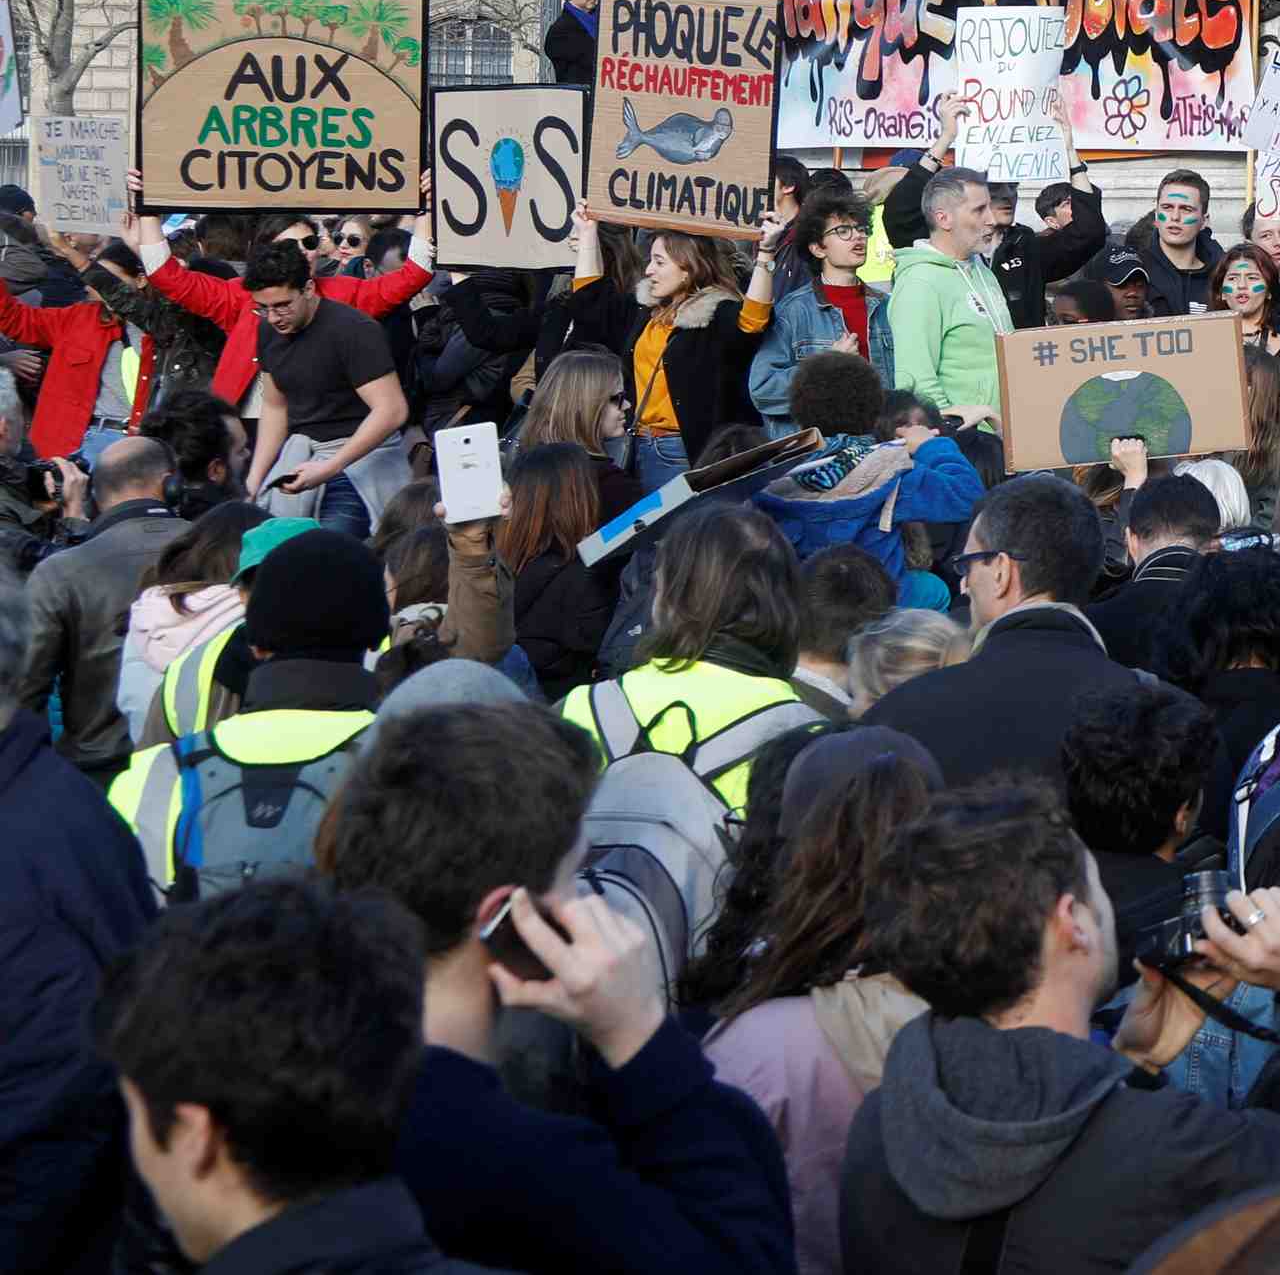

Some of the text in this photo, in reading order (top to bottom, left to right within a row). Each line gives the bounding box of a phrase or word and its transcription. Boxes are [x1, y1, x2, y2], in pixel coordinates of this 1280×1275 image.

[743, 6, 778, 70] LE
[960, 13, 1065, 63] RAJOUTEZ
[224, 52, 351, 103] AUX
[600, 52, 774, 106] RÉCHAUFFEMENT
[997, 62, 1016, 74] DU
[960, 78, 1060, 124] ROUND UP
[1257, 98, 1269, 111] Y
[1272, 103, 1280, 118] A
[44, 121, 63, 138] JE
[198, 105, 375, 149] ARBRES
[966, 125, 1064, 145] ENLEVEZ
[180, 149, 406, 193] CITOYENS
[608, 168, 774, 229] CLIMATIQUE
[1070, 335, 1126, 364] SHE
[1131, 328, 1193, 358] TOO
